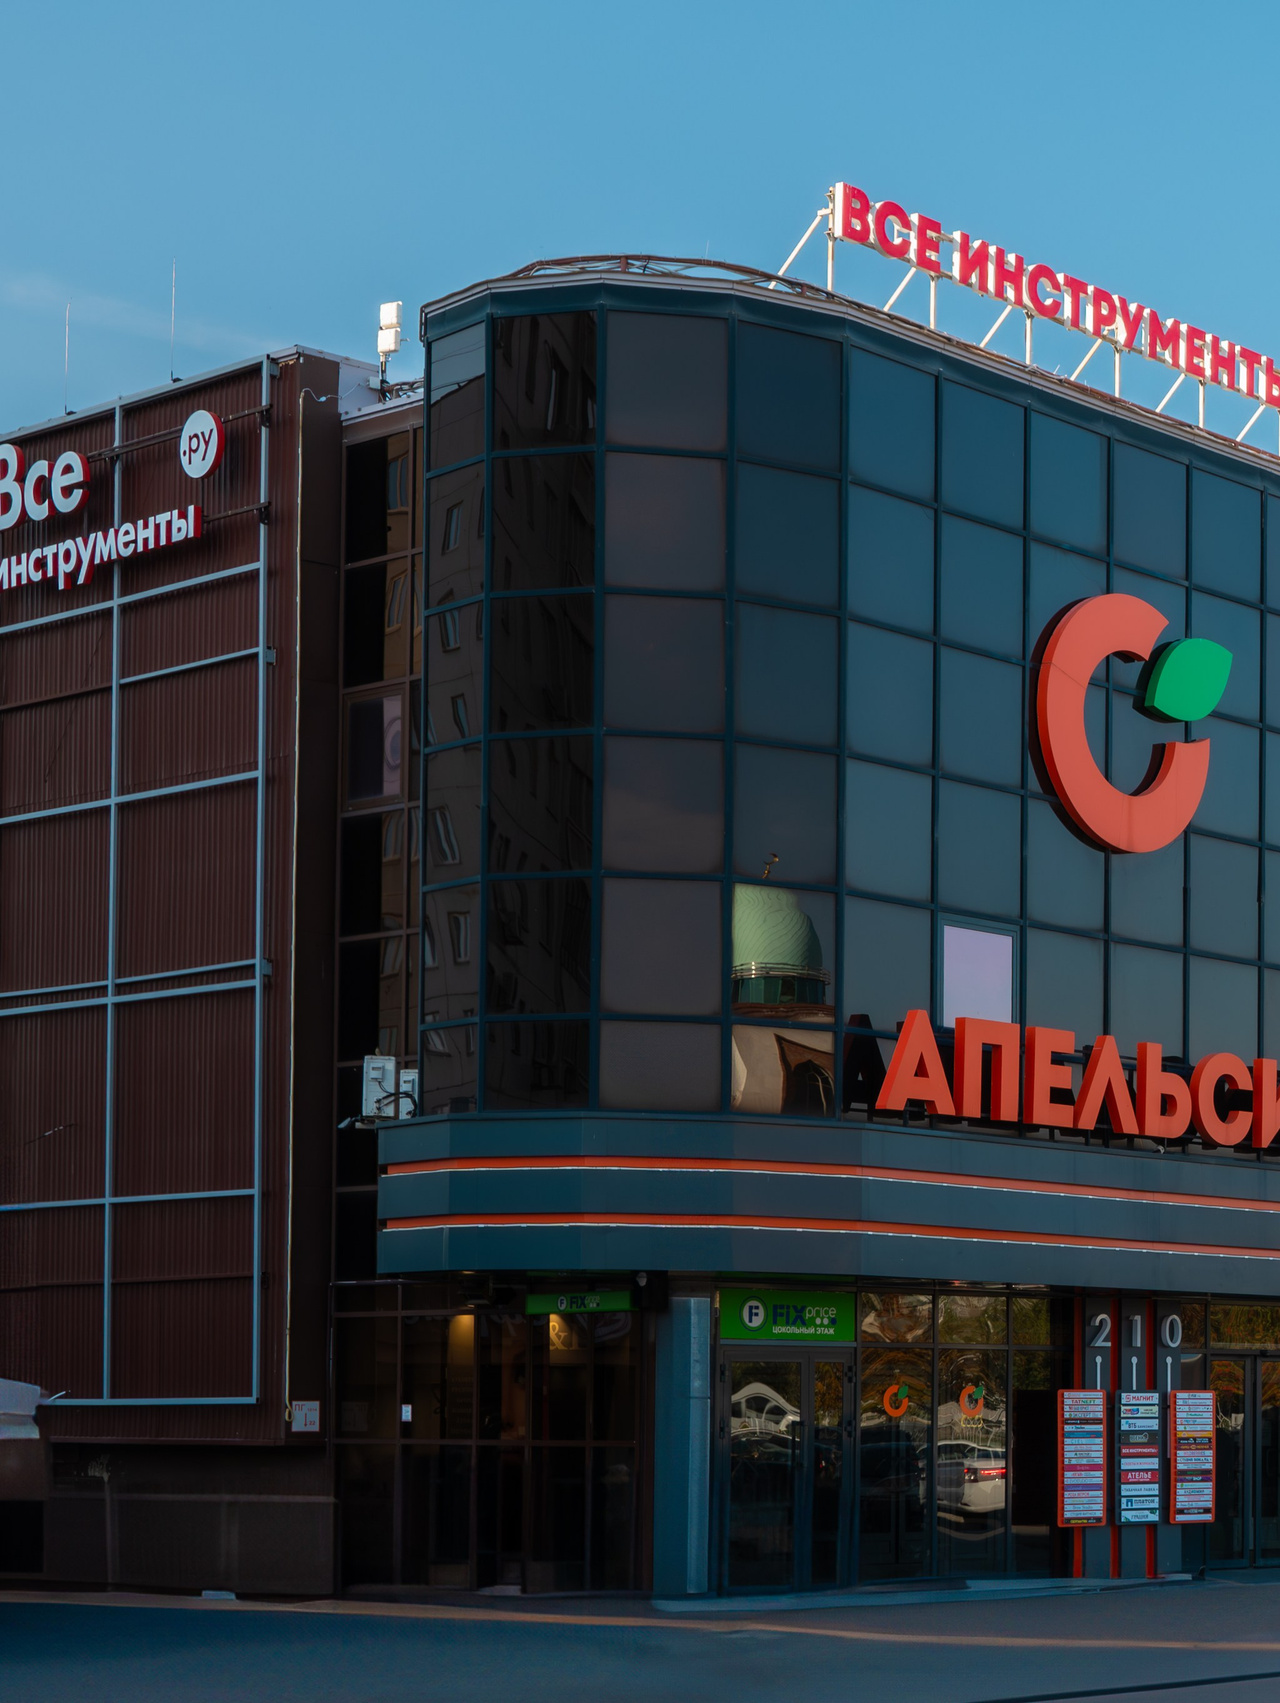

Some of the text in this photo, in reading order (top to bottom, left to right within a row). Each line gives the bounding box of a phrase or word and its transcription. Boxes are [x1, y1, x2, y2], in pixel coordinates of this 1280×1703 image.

[834, 182, 942, 275] ВСЕ
[805, 1306, 837, 1320] price
[772, 1325, 835, 1335] ЦОКОЛЬНЫЙ ЭТАЖ
[1090, 1313, 1183, 1348] 2 1 0
[294, 1403, 306, 1412] ПГ
